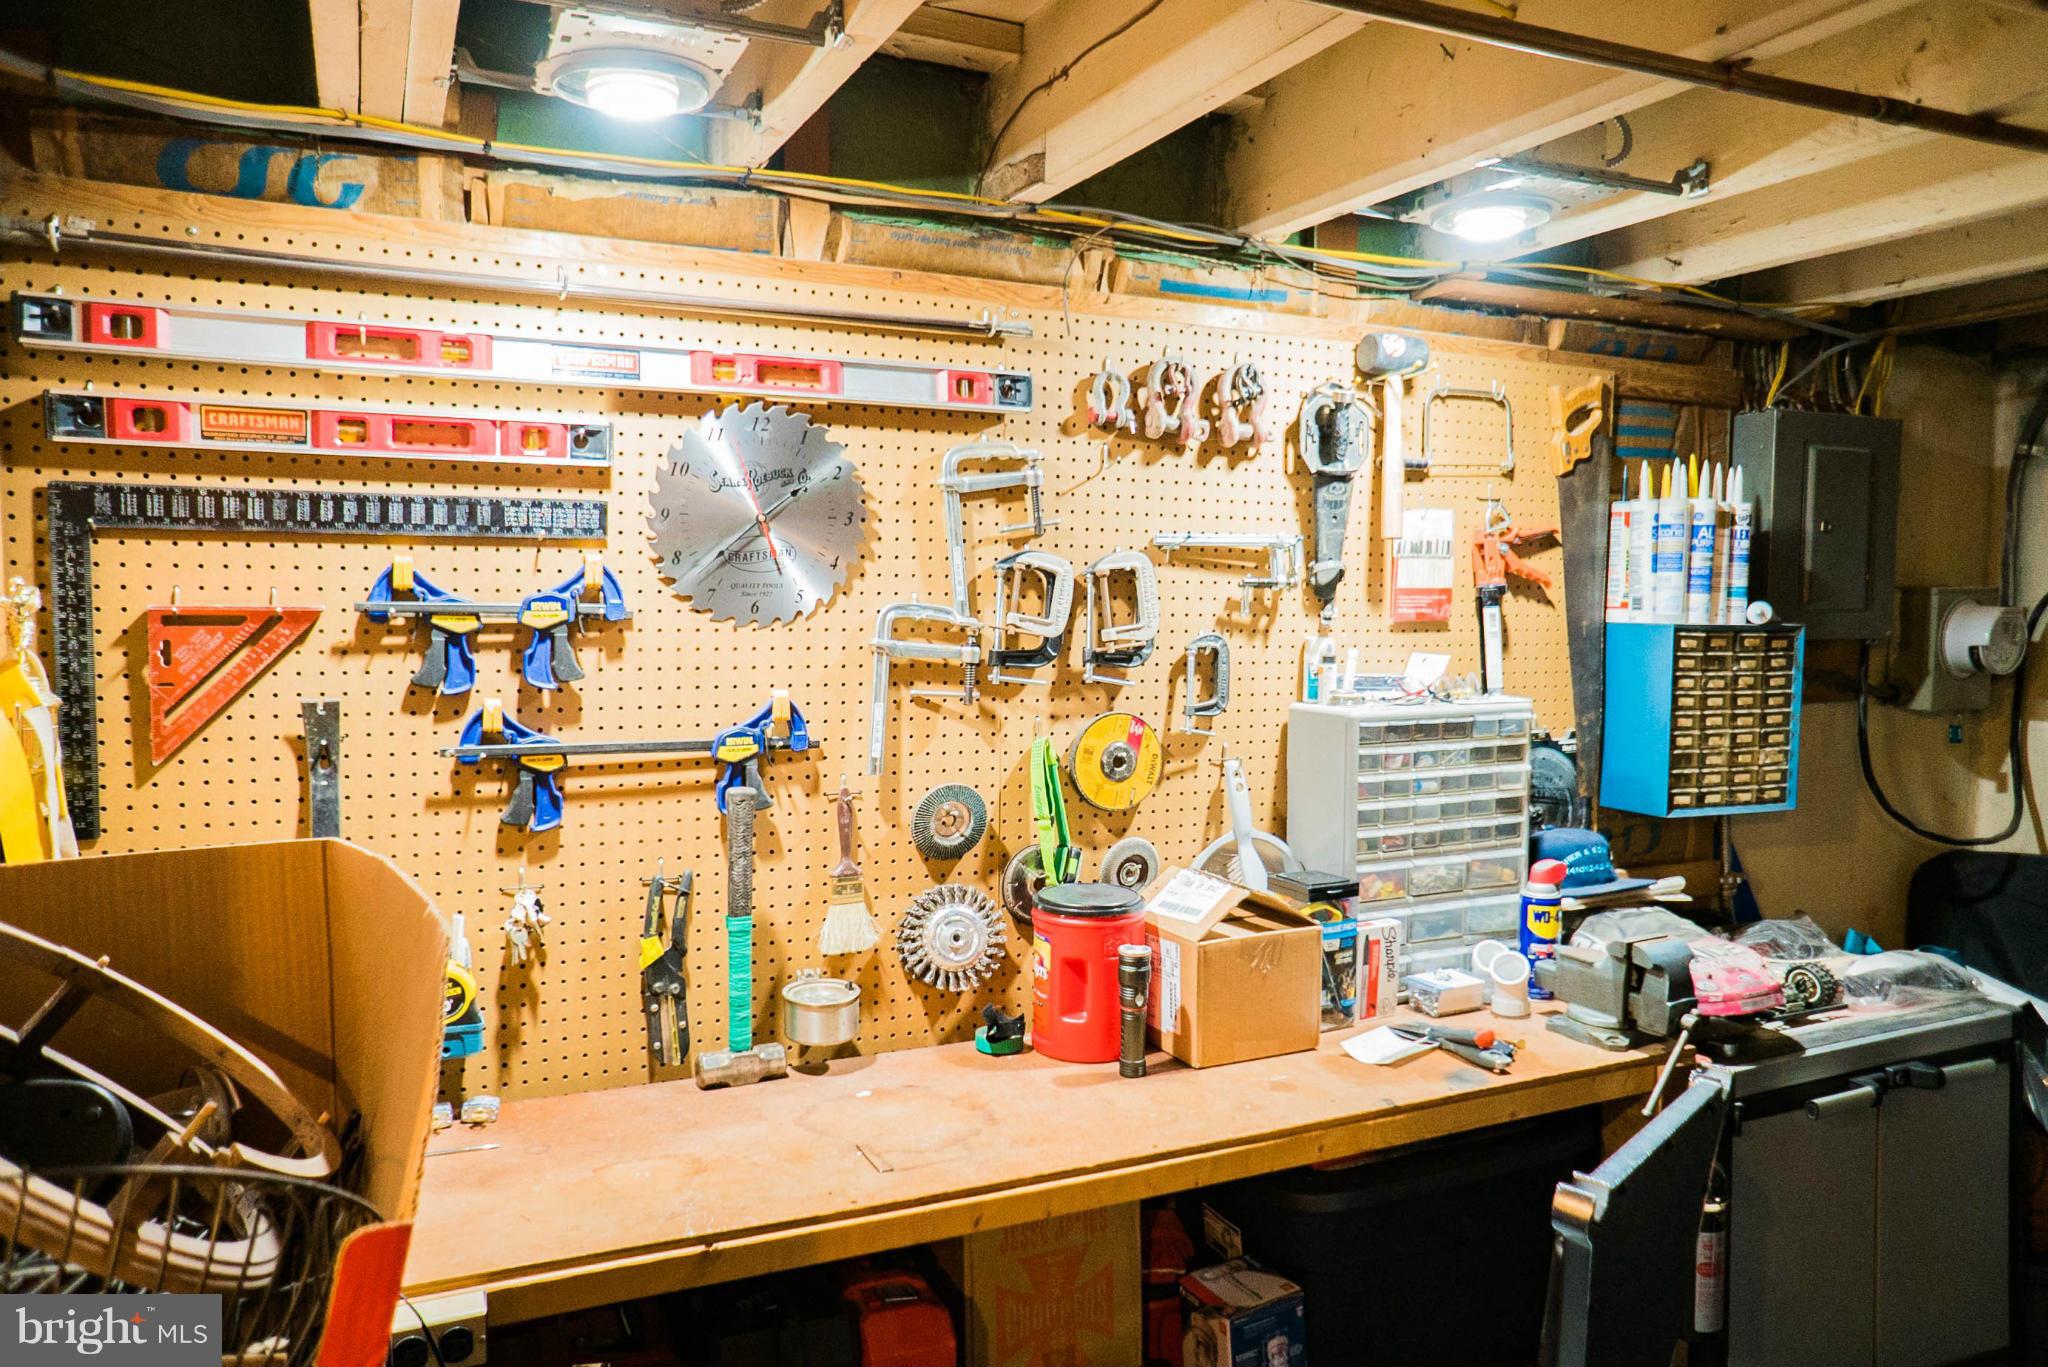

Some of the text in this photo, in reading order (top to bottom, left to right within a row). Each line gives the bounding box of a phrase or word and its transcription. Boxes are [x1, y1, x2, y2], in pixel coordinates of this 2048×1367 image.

[208, 411, 300, 430] CRAFTSMAN
[752, 416, 771, 432] 12
[708, 428, 724, 442] 11
[800, 430, 809, 446] 1
[670, 461, 690, 477] 10
[832, 465, 843, 481] 2
[660, 508, 670, 522] 9
[844, 511, 854, 526] 3
[671, 551, 682, 566] 8
[829, 555, 840, 571] 4
[706, 588, 717, 602] 7
[795, 589, 805, 604] 5
[750, 600, 760, 615] 6
[725, 736, 754, 747] IRWIN
[1533, 910, 1561, 924] WD-4
